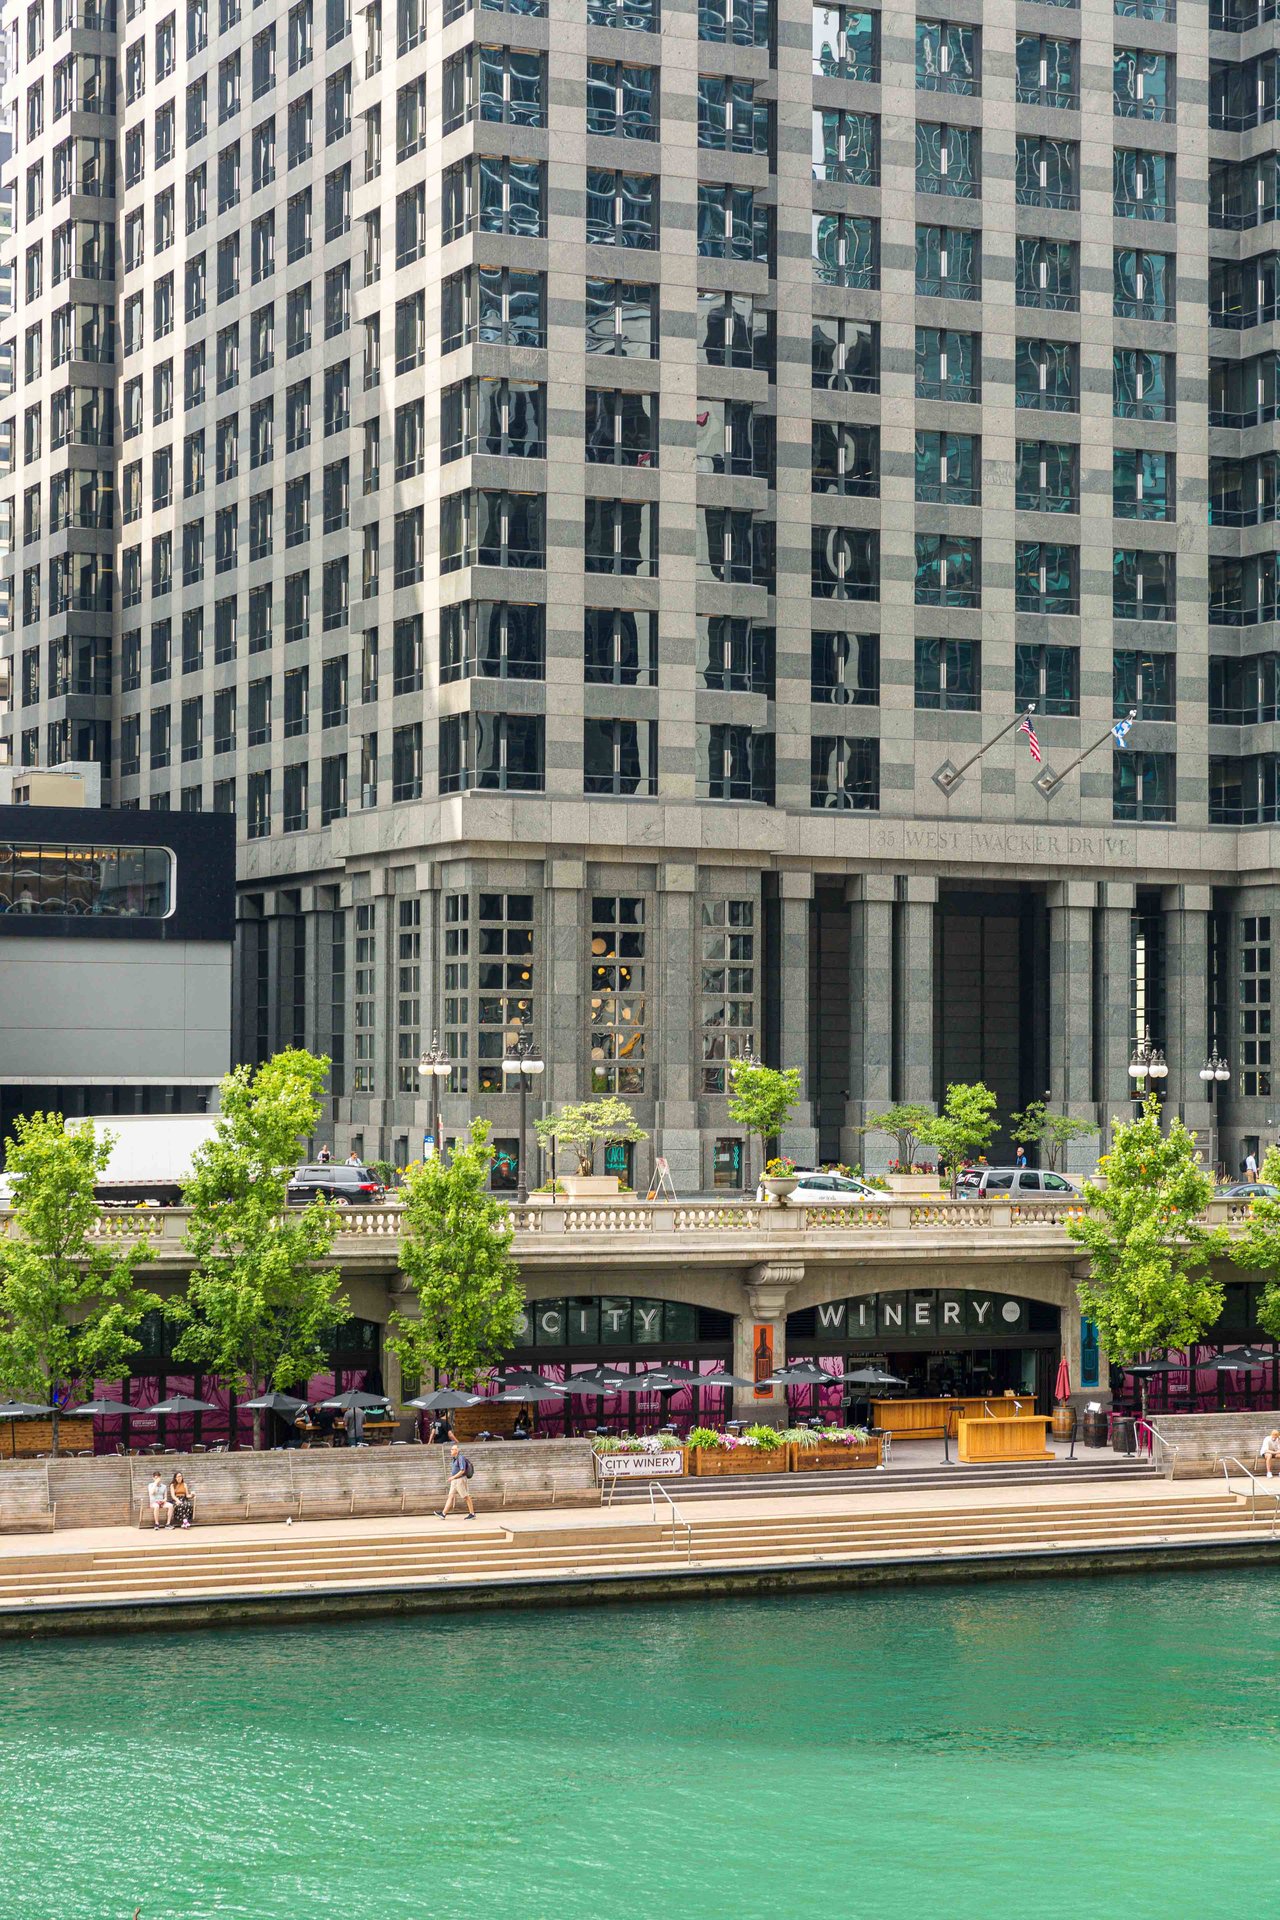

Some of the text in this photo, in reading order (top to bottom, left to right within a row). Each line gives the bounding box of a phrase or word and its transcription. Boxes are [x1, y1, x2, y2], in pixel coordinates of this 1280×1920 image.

[877, 831, 895, 847] 35
[906, 831, 961, 849] WEST
[974, 833, 1058, 853] WACKER
[541, 1309, 657, 1334] CITY
[818, 1301, 991, 1327] WINERY
[605, 1457, 676, 1469] CITY WINERY
